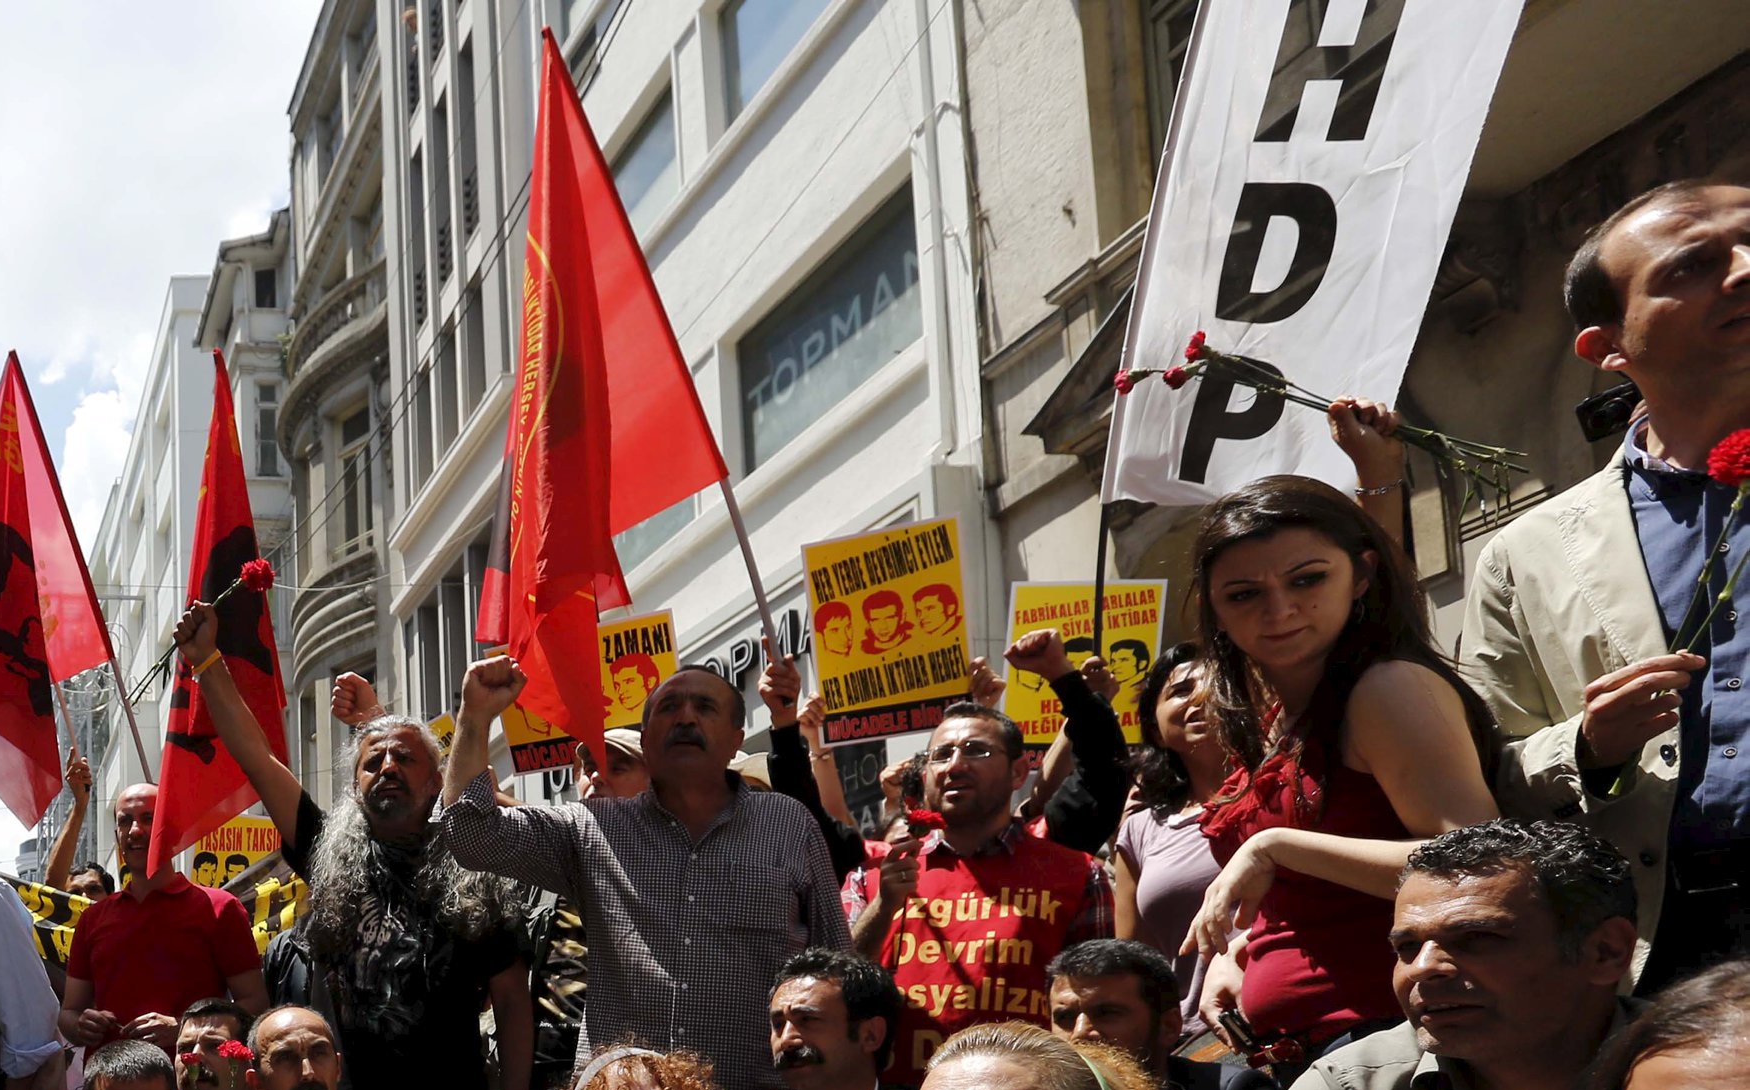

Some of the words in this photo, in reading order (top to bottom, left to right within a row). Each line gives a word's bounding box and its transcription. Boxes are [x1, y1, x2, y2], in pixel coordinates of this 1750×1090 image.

[1179, 0, 1406, 484] HDP
[811, 567, 835, 603] HER
[831, 556, 867, 597] YERDE
[914, 524, 954, 570] EYLEM
[602, 622, 672, 664] ZAMANI
[827, 711, 908, 740] MÜCADELE
[893, 887, 1062, 928] zgürlük
[894, 931, 1034, 966] Devrim
